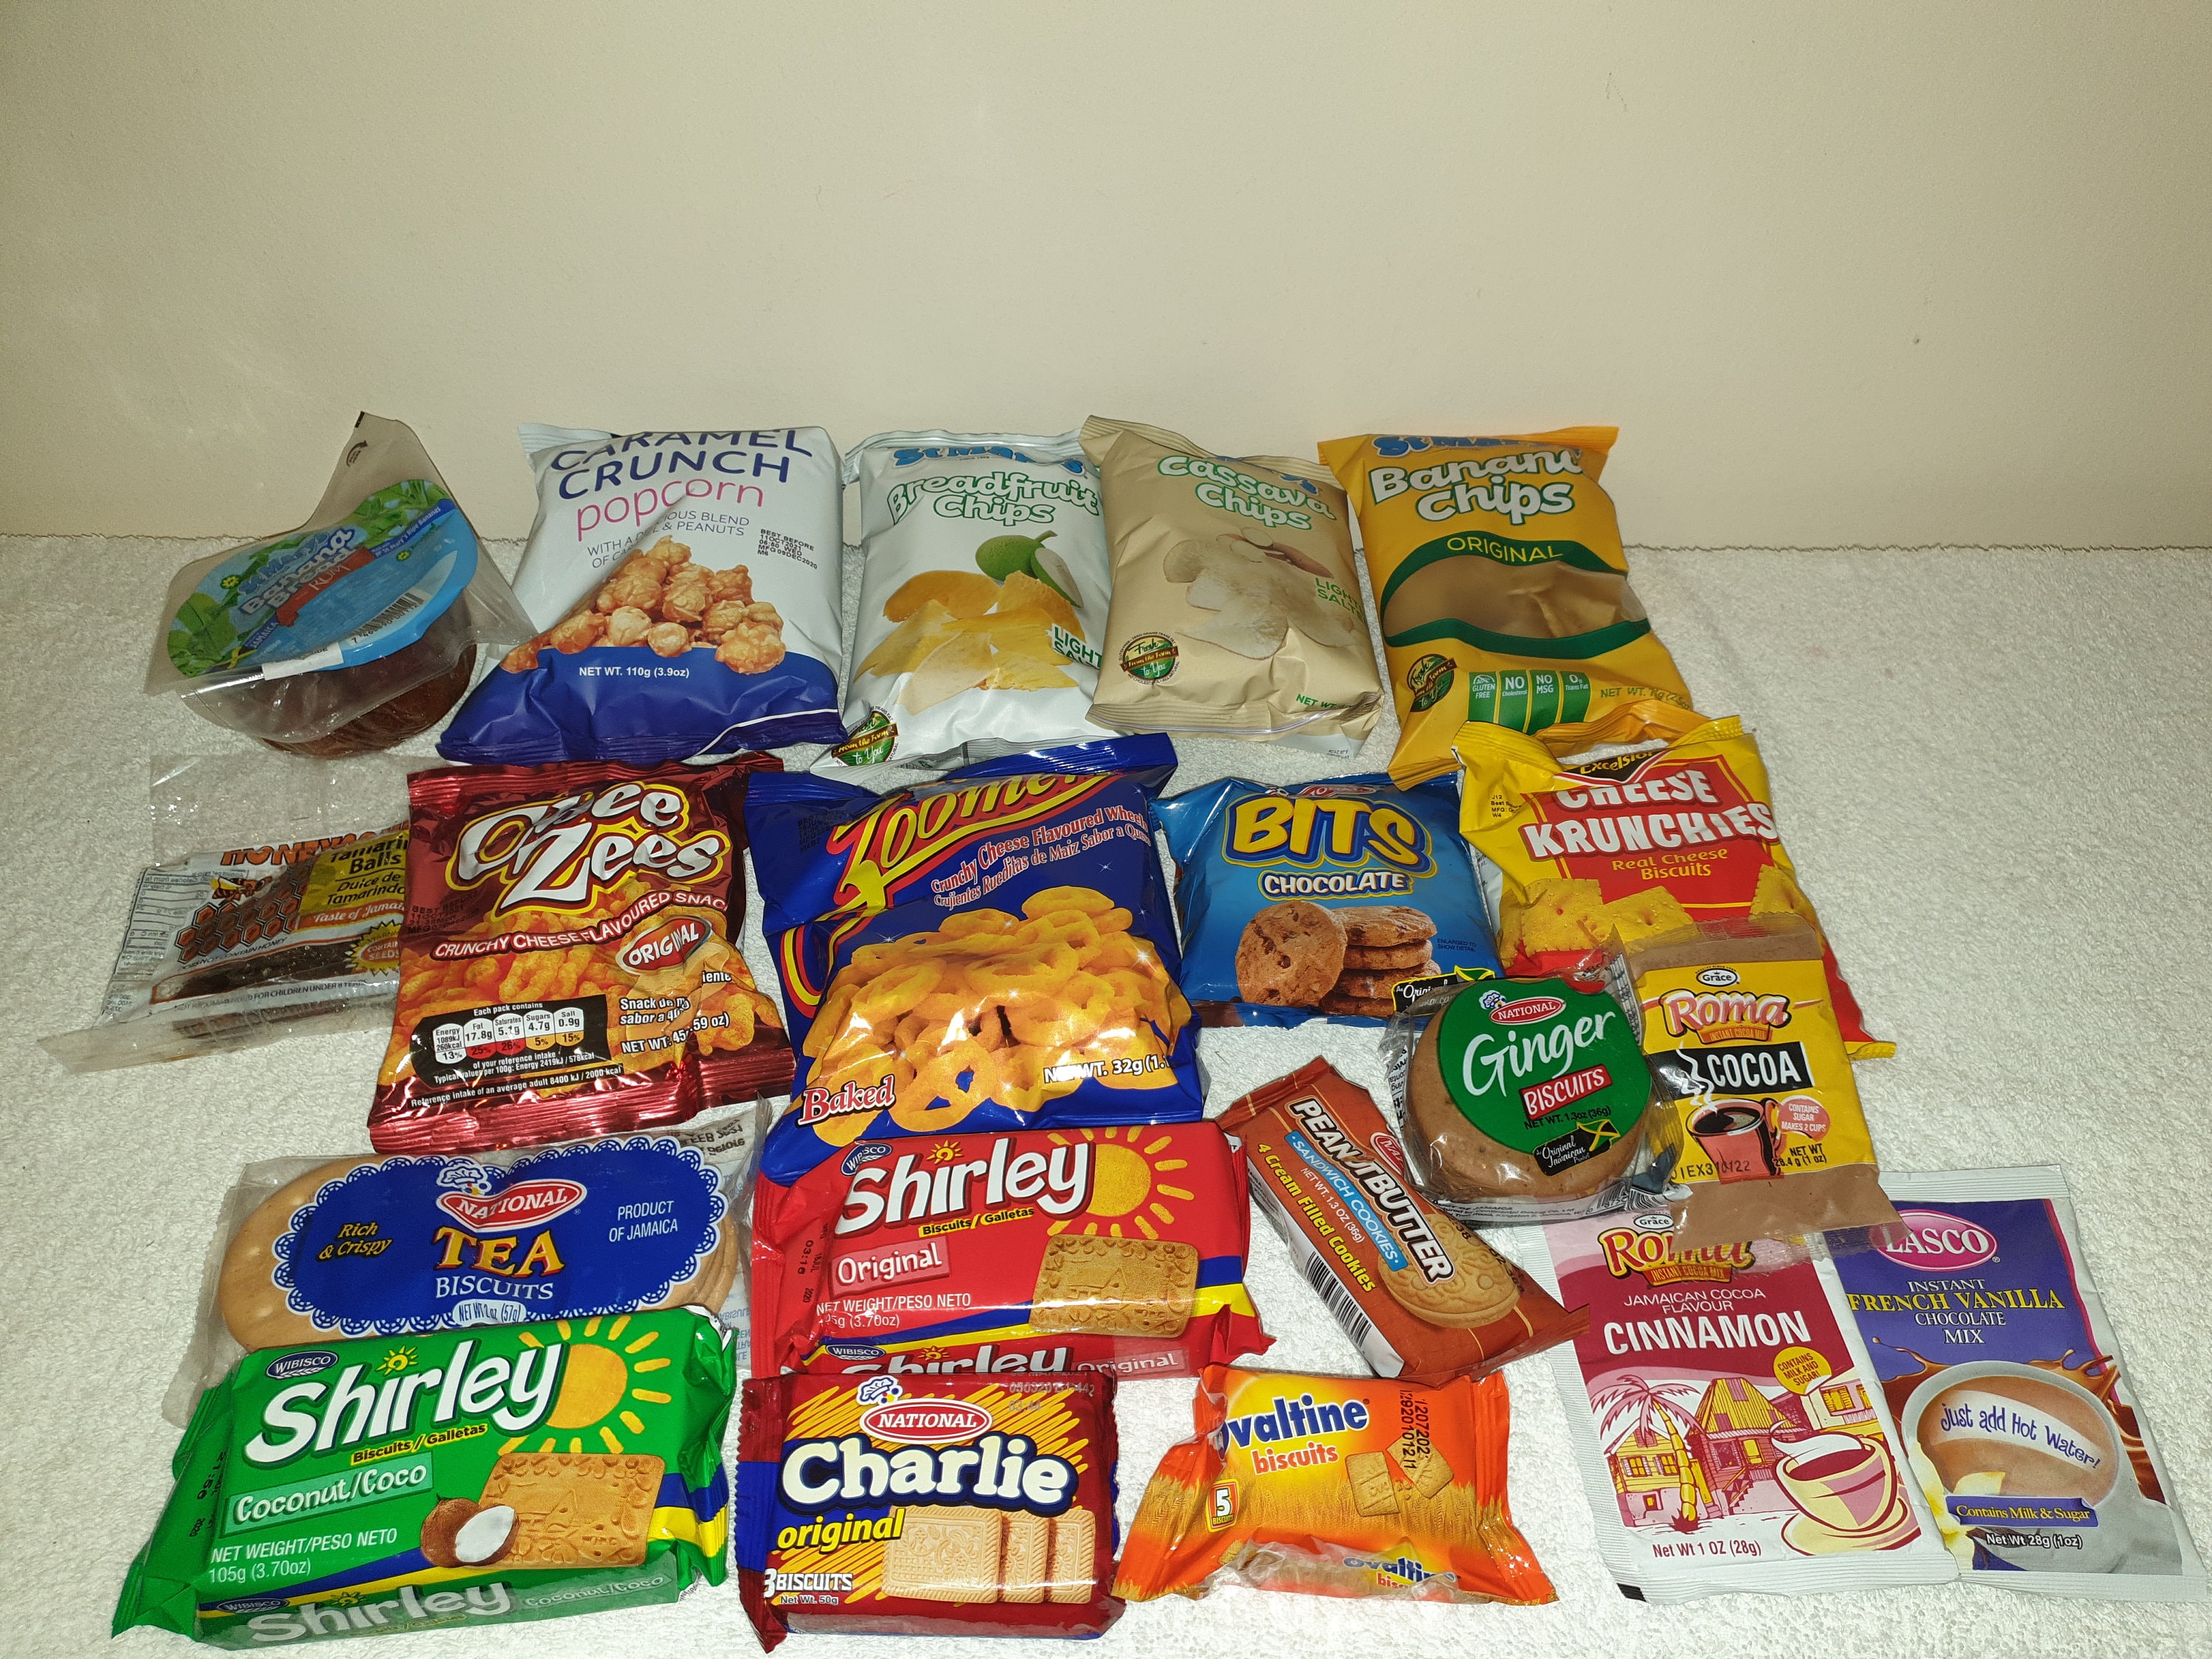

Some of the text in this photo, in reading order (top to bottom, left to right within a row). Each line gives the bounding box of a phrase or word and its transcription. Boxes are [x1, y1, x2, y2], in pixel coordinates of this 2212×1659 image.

[559, 451, 790, 499] CRUNCH
[886, 472, 1099, 525] Breadfruit
[1158, 455, 1337, 521] Cassava
[1195, 483, 1312, 530] Chips
[1416, 473, 1574, 525] Chips
[577, 479, 764, 541] popcorn
[701, 512, 750, 526] BLEND
[933, 494, 1056, 526] Chips
[677, 521, 745, 537] PEANUTS
[588, 540, 622, 557] WITH
[1447, 536, 1563, 563] ORIGINAL
[592, 556, 609, 568] OF
[309, 565, 350, 591] RUM
[1128, 639, 1158, 654] Fresh
[579, 667, 690, 678] NET WT. 110g (3.9oz)
[1141, 661, 1166, 677] to You
[1536, 674, 1552, 685] NO
[1472, 683, 1496, 692] GLUTEN
[1505, 676, 1525, 690] NO
[1536, 684, 1554, 695] MSG
[1232, 796, 1420, 866] BITS
[1523, 803, 1780, 858] KRUNCHIES
[931, 804, 1149, 893] Crunchy Cheese Flavoured Wheels
[349, 852, 401, 874] Balls
[934, 826, 1114, 911] Crujientes Rueditas de Maiz Sabor
[1613, 848, 1728, 871] Real Cheese
[382, 872, 401, 882] de
[1641, 862, 1712, 880] Biscuits
[1263, 871, 1410, 896] CHOCOLATE
[314, 911, 345, 922] Taste
[434, 891, 670, 958] CRUNCHY CHEESE FLAVOURED
[627, 922, 700, 967] ORIGINAL
[1702, 973, 1732, 981] Grace
[473, 1002, 543, 1016] Each pack contains
[620, 998, 656, 1010] Snack
[1498, 1001, 1557, 1020] NATIONAL
[1663, 989, 1791, 1037] Roma
[495, 1017, 521, 1026] Saturates
[526, 1013, 551, 1022] Sugars
[528, 1021, 550, 1032] 4.7g
[558, 1018, 580, 1028] 0.9g
[620, 1012, 655, 1025] sabor
[465, 1031, 493, 1042] 17.8g
[621, 1037, 672, 1054] NET WT:
[496, 1051, 556, 1065] reference intake
[1462, 1012, 1616, 1097] Ginger
[1112, 1057, 1144, 1076] 32g
[1707, 1050, 1802, 1088] COCOA
[496, 1075, 568, 1093] average adult 8400
[1523, 1068, 1605, 1116] BISCUITS
[798, 1074, 896, 1126] Baked
[1788, 1103, 1819, 1113] CONTAINS
[1565, 1105, 1612, 1121] 1.3oz (36g)
[1792, 1113, 1815, 1121] SUGAR
[1781, 1121, 1826, 1132] MAKES CUPS
[835, 1138, 1090, 1239] Shirley
[457, 1189, 569, 1220] NATIONAL
[616, 1200, 674, 1221] PRODUCT
[1293, 1140, 1399, 1260] SANDWICH COOKIES
[340, 1221, 378, 1240] Rich
[625, 1219, 679, 1240] JAMAICA
[922, 1207, 1035, 1236] Biscuits Galletas
[1265, 1152, 1376, 1293] Cream Filled Cookies
[1364, 1173, 1455, 1281] BUTTER
[335, 1235, 393, 1258] Crispy
[1885, 1228, 1989, 1254] LASCO
[434, 1226, 565, 1279] TEA
[838, 1242, 942, 1284] Original
[435, 1276, 554, 1300] BISCUITS
[1907, 1278, 1986, 1293] INSTANT
[816, 1293, 971, 1316] NET WEIGHT/PESO NETO
[1623, 1288, 1766, 1308] JAMAICAN COCOA
[1661, 1300, 1734, 1314] FLAVOUR
[1849, 1288, 2065, 1312] FRENCH VANILLA
[1914, 1311, 2006, 1327] CHOCOLATE
[1604, 1311, 1812, 1355] CINNAMON
[1944, 1329, 1986, 1344] MIX
[832, 1345, 880, 1358] WIBISCO
[1778, 1352, 1814, 1371] CONTAINS
[274, 1353, 332, 1374] WIBISCO
[1784, 1361, 1819, 1380] MILK AND
[245, 1339, 566, 1467] Shirley
[877, 1411, 978, 1428] NATIONAL
[352, 1425, 487, 1464] Biscuits Galletas
[1941, 1402, 2101, 1470] just add Hot Water!
[1252, 1442, 1339, 1475] biscuits
[782, 1435, 1069, 1505] Charlie
[237, 1463, 428, 1523] Coconut/Coco
[1215, 1489, 1232, 1517] 5
[1955, 1503, 2090, 1522] Contains Milk Sugar
[776, 1507, 906, 1553] original
[211, 1528, 398, 1563] NET WEIGHT/PESO NETO
[1652, 1540, 1762, 1559] Net Wt OZ (28g)
[1986, 1533, 2084, 1550] Net Wt 28g (1oz)
[208, 1558, 312, 1585] 105g (3.70oz)
[246, 1582, 512, 1643] Shirley
